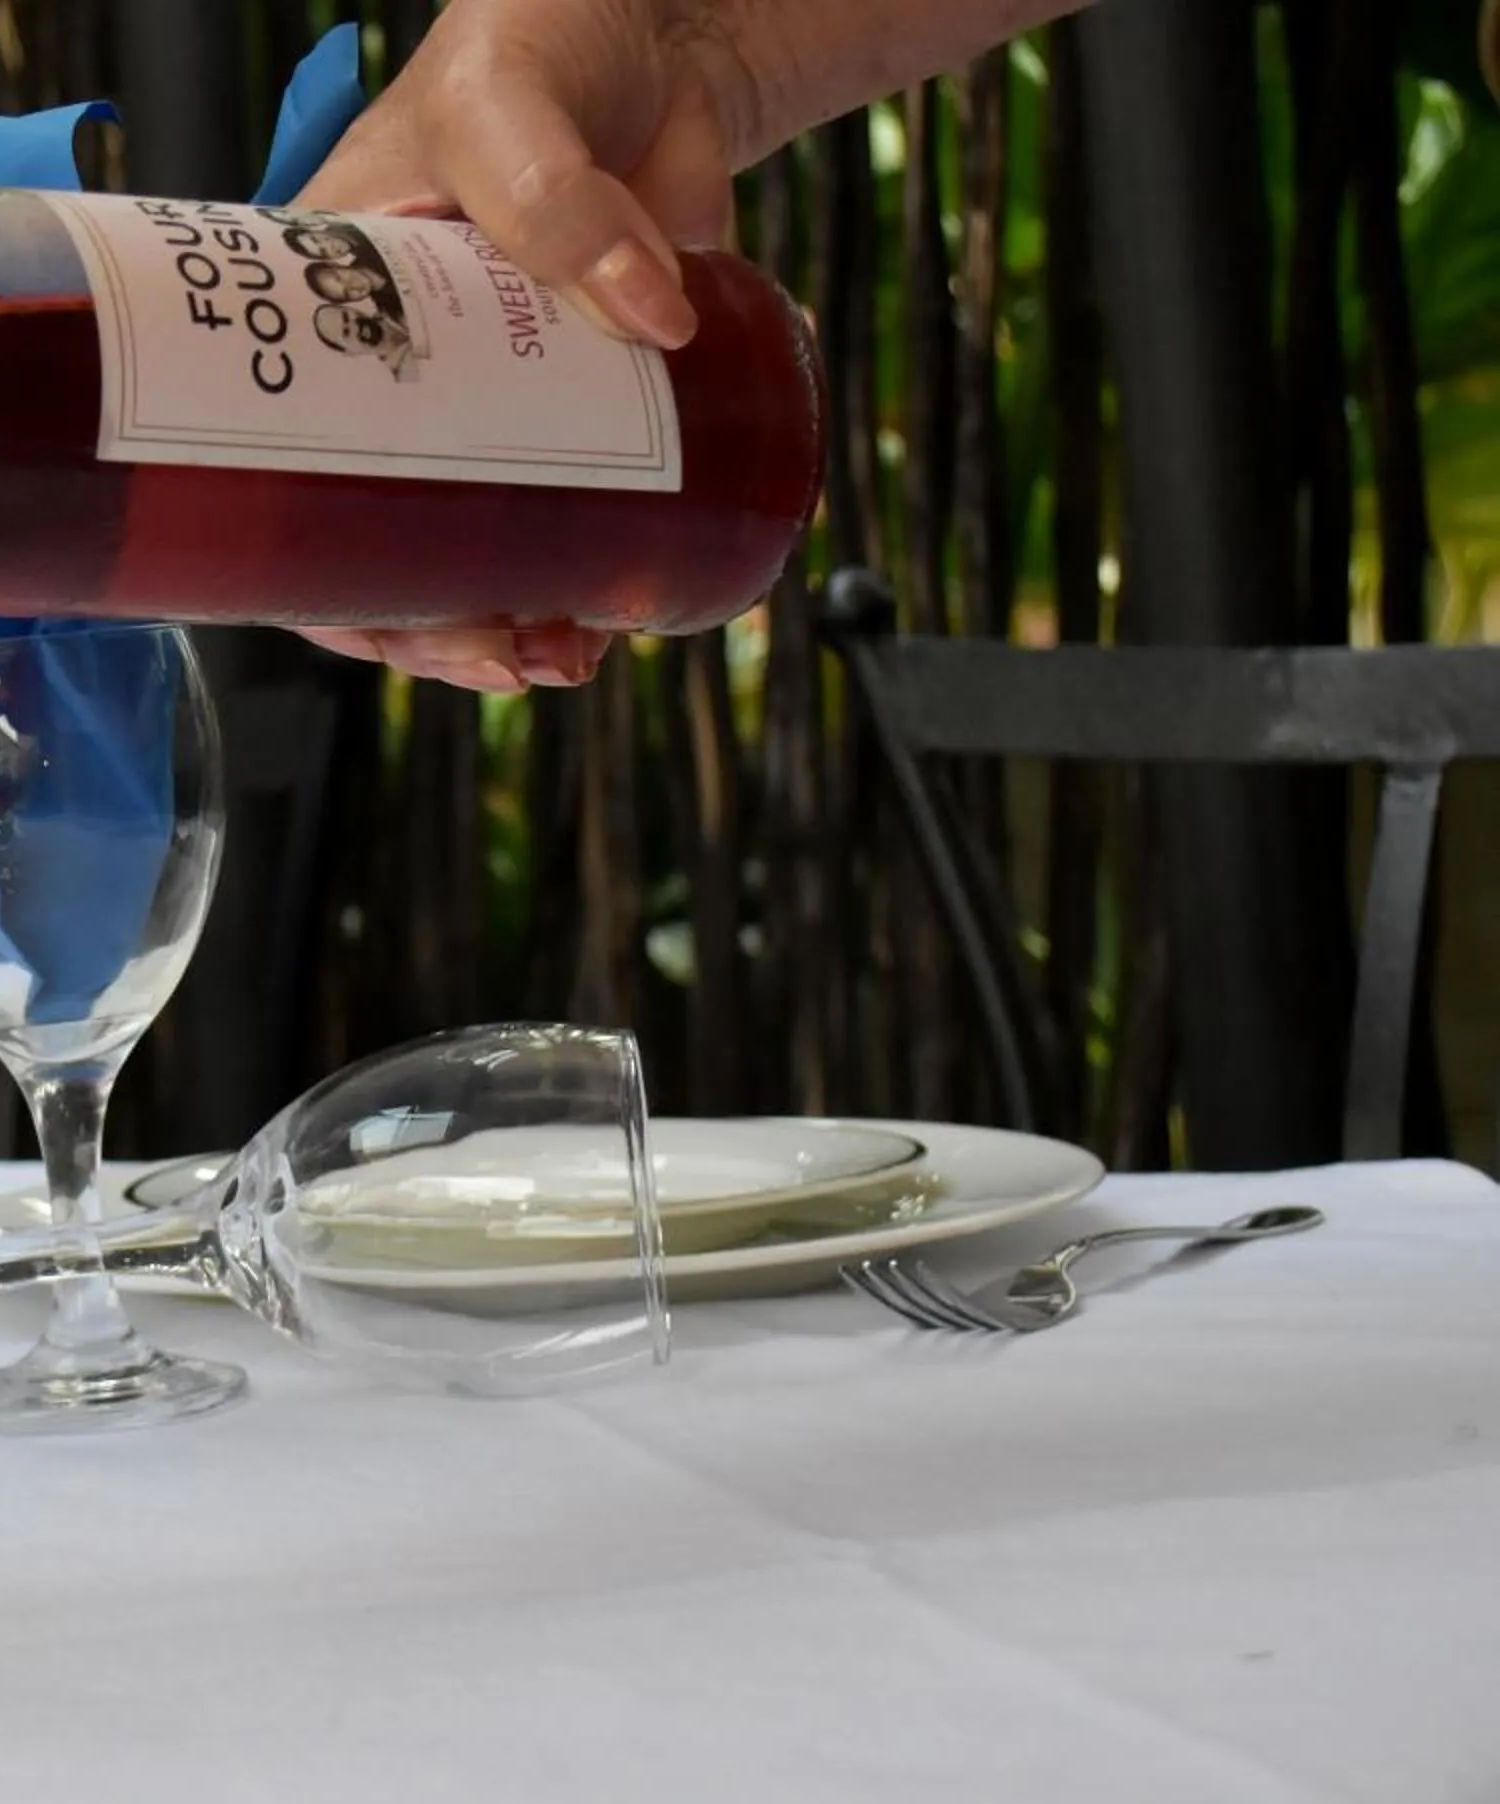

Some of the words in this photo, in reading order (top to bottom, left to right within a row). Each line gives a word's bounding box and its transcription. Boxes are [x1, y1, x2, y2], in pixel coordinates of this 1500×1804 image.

[134, 201, 233, 330] FOUR
[445, 222, 506, 263] ROS
[196, 204, 294, 394] COUSIN
[484, 264, 545, 360] SWEET
